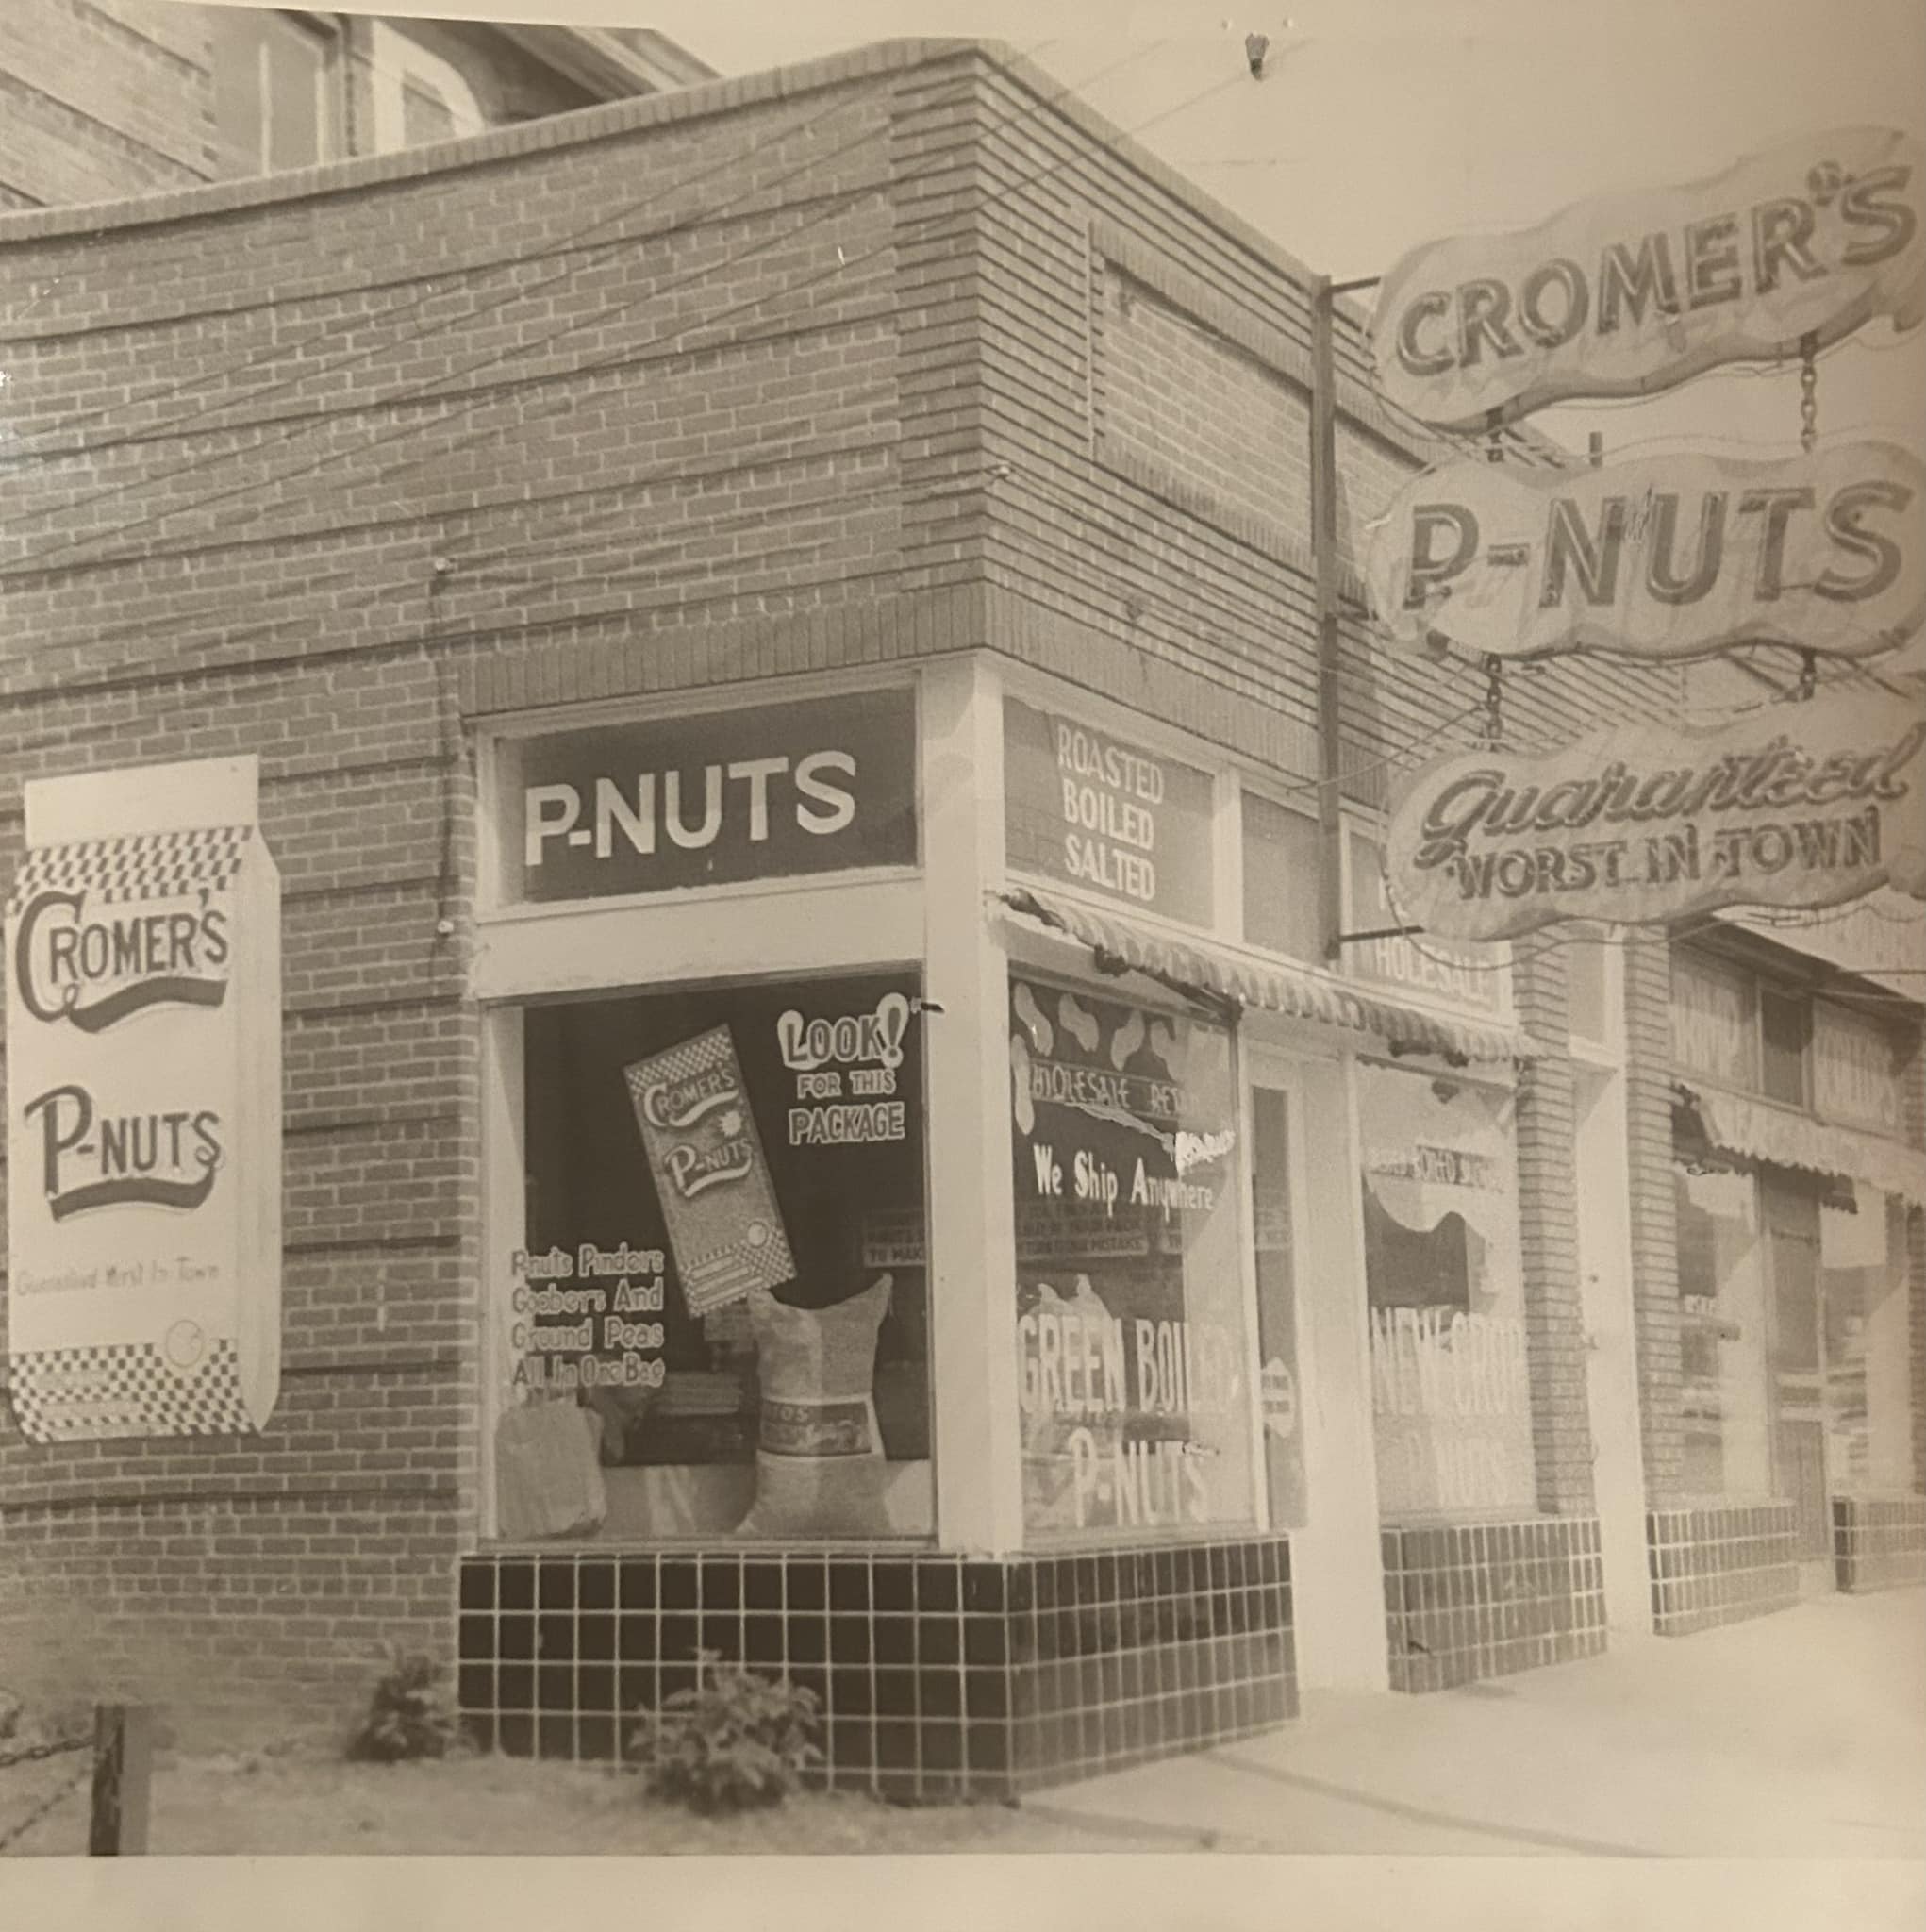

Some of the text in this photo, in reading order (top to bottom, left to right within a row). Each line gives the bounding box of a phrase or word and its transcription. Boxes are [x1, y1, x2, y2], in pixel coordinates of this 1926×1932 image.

[1396, 161, 1917, 377] CROMER'S
[1403, 479, 1916, 610] P-NUTS
[1057, 724, 1165, 804] ROASTED
[525, 750, 856, 866] P-NUTS
[1063, 777, 1155, 851] BOILED
[1064, 832, 1156, 901] SALTED
[1447, 805, 1883, 901] WORST IN TOWN
[15, 889, 230, 1024] CROMER'S
[777, 992, 909, 1069] LOOK!
[797, 1069, 896, 1099] FOR THIS
[1032, 1063, 1132, 1110] HOLESALE
[24, 1085, 224, 1200] P-NUTS
[789, 1102, 905, 1145] PACKAGE
[664, 1137, 753, 1192] P-NUTS
[1033, 1143, 1064, 1196] We
[1073, 1150, 1119, 1218] Ship
[1130, 1157, 1215, 1223] Anywhere
[511, 1315, 665, 1352] Ground Peas
[614, 1276, 665, 1313] And
[512, 1355, 545, 1388] All
[1017, 1312, 1240, 1416] GREEN BOIL
[1069, 1425, 1210, 1530] P-NUTS
